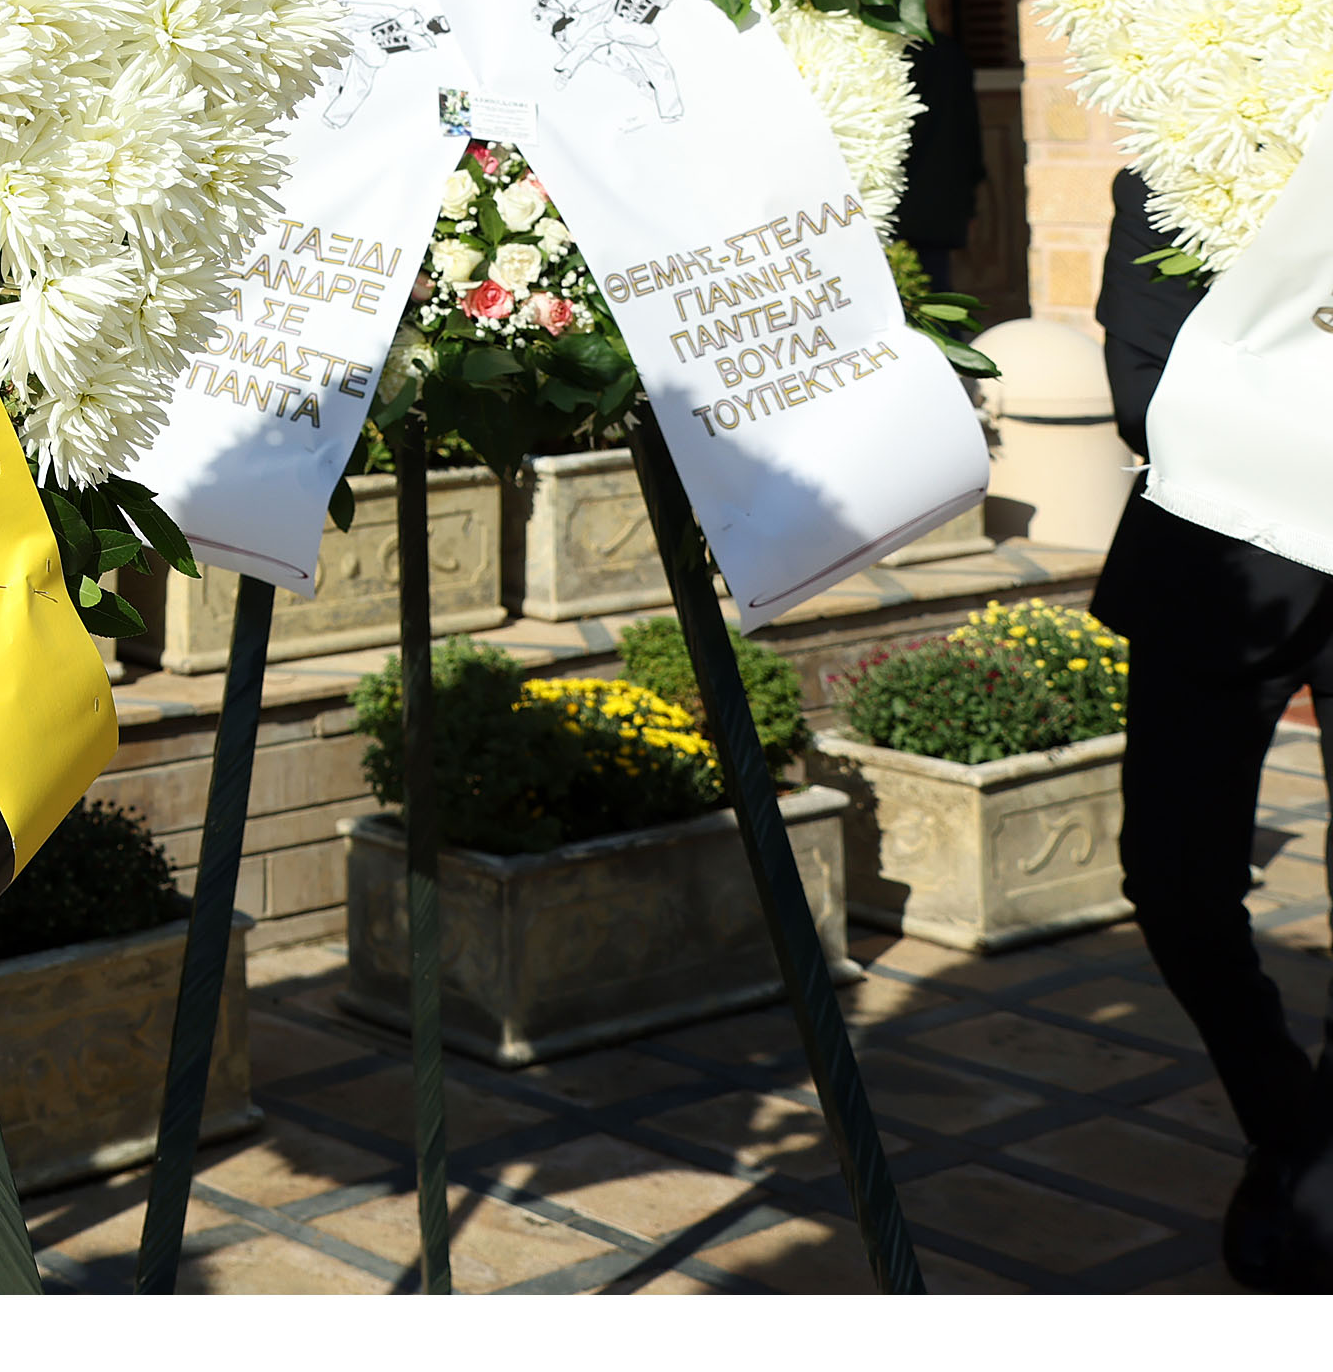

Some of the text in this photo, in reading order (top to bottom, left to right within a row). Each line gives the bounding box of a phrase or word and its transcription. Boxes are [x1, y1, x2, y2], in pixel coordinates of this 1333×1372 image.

[278, 218, 402, 278] ΤΑΞΙΔΙ
[254, 297, 310, 336] ΣΕ
[669, 276, 852, 364] ΠΑΝΤΕΛΗΣ
[672, 248, 822, 322] ΓΙΑΝΝΗΣ
[203, 324, 373, 399] ΟΜΑΣΤΕ
[691, 341, 900, 438] ΤΟΥΠΕΚΤΣΗ
[714, 325, 837, 388] ΒΟΥΛΑ
[185, 359, 321, 429] ΠΑΝΤΑ
